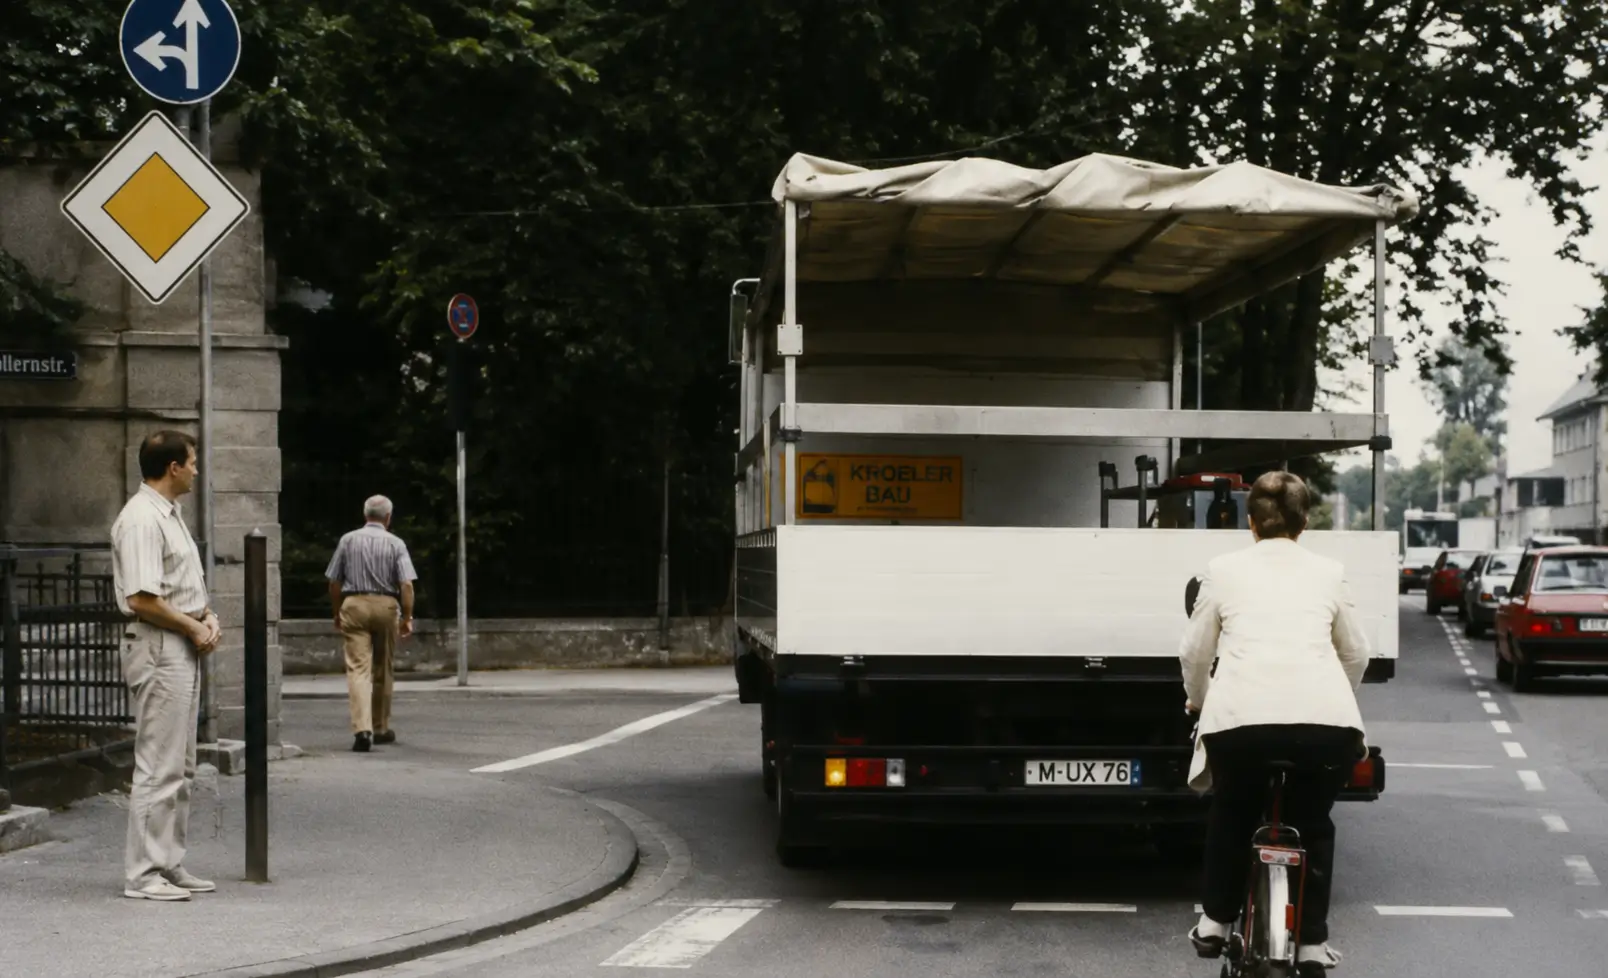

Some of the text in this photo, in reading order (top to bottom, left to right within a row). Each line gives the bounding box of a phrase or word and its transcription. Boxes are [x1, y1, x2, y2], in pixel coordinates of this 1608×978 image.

[850, 464, 953, 482] KROELER
[865, 485, 911, 503] BAU
[1039, 762, 1129, 783] M-UX 76
